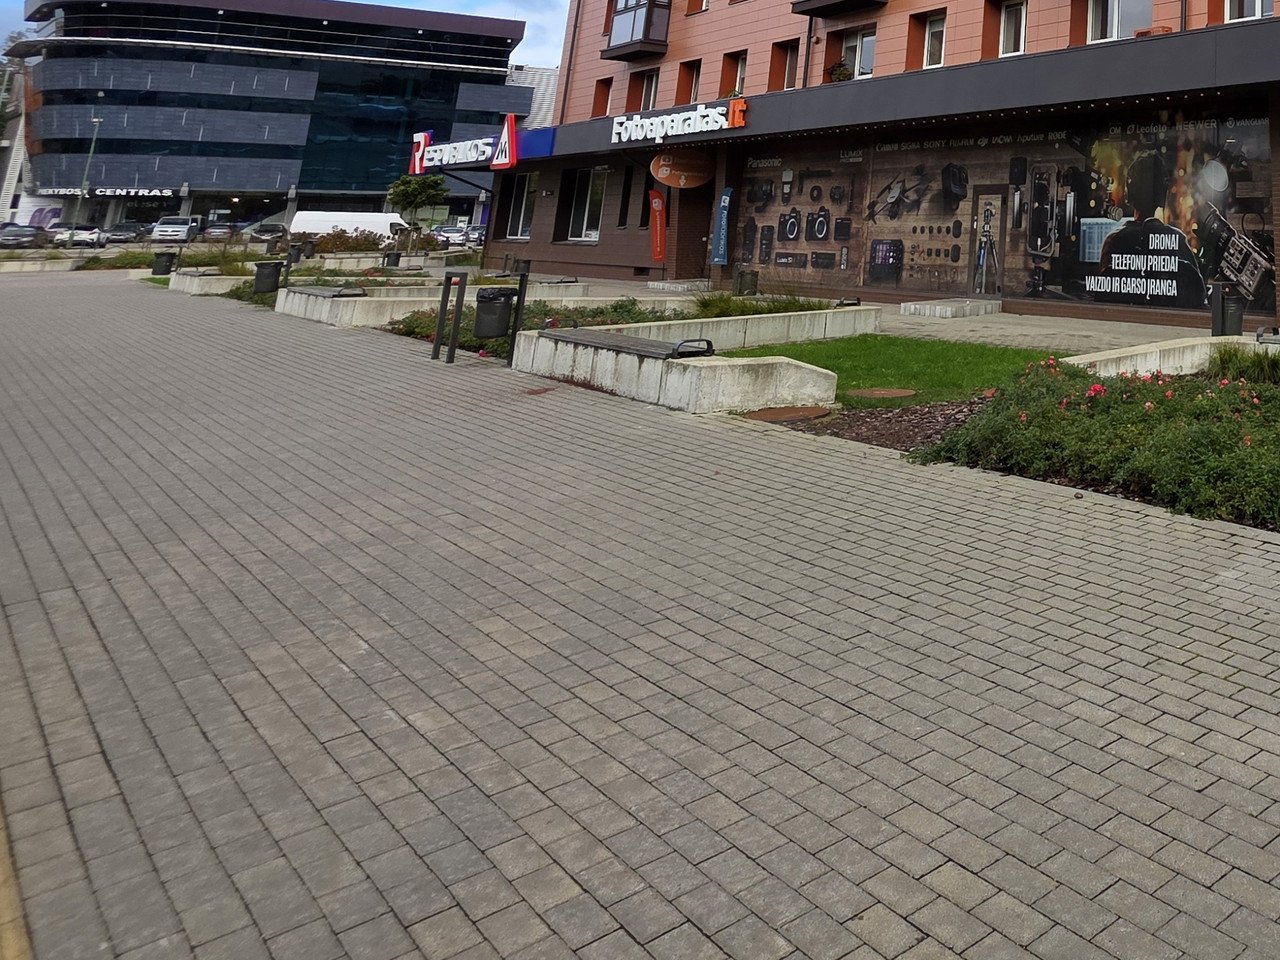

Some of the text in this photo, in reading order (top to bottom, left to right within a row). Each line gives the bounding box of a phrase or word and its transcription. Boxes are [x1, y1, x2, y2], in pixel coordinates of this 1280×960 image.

[611, 98, 748, 144] Fotoaparatas.lt
[1235, 117, 1270, 127] VANGUAR
[923, 139, 947, 149] SONY
[747, 156, 782, 168] Panasonic
[95, 188, 173, 196] CENTRAS
[1149, 233, 1179, 251] DRONAI
[1111, 254, 1179, 276] TELEFONŲ PRIEDAI
[1085, 276, 1178, 300] VAIZDO IR GARSO ĮRANGA
